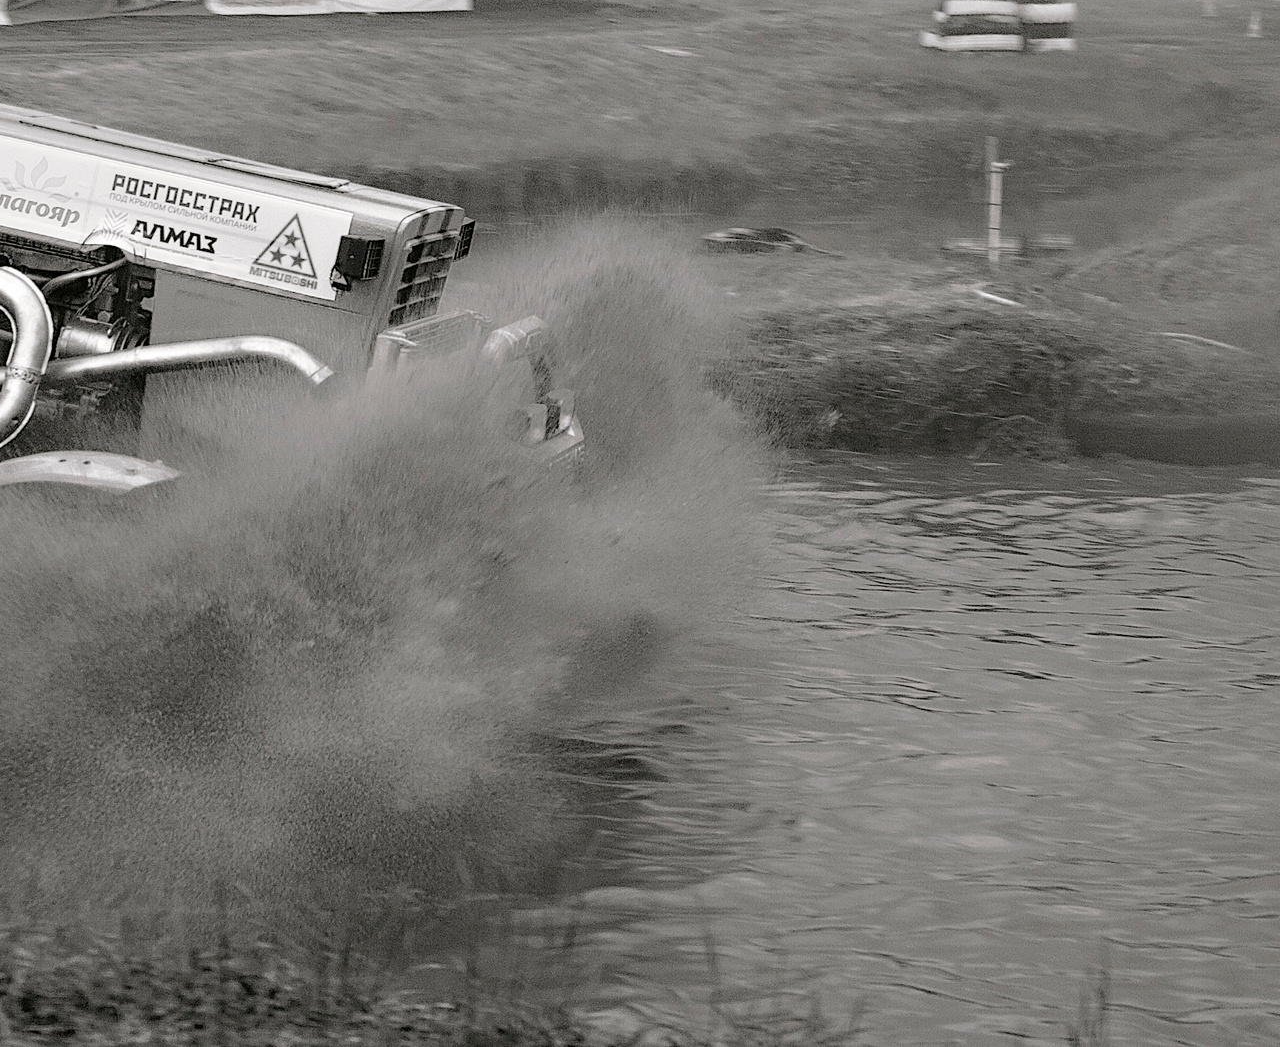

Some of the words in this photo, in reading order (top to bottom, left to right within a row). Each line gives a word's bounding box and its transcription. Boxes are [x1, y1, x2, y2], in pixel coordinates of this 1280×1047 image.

[109, 192, 128, 204] ПОД
[128, 197, 166, 211] КРЫЛОМ
[167, 205, 209, 221] СИЛЬНОЙ
[209, 215, 258, 232] КОМПАНИИ
[112, 174, 260, 223] РОСГОССТРАХ
[131, 219, 218, 254] АЛМАЗ
[249, 265, 318, 290] MITSUBOSHI
